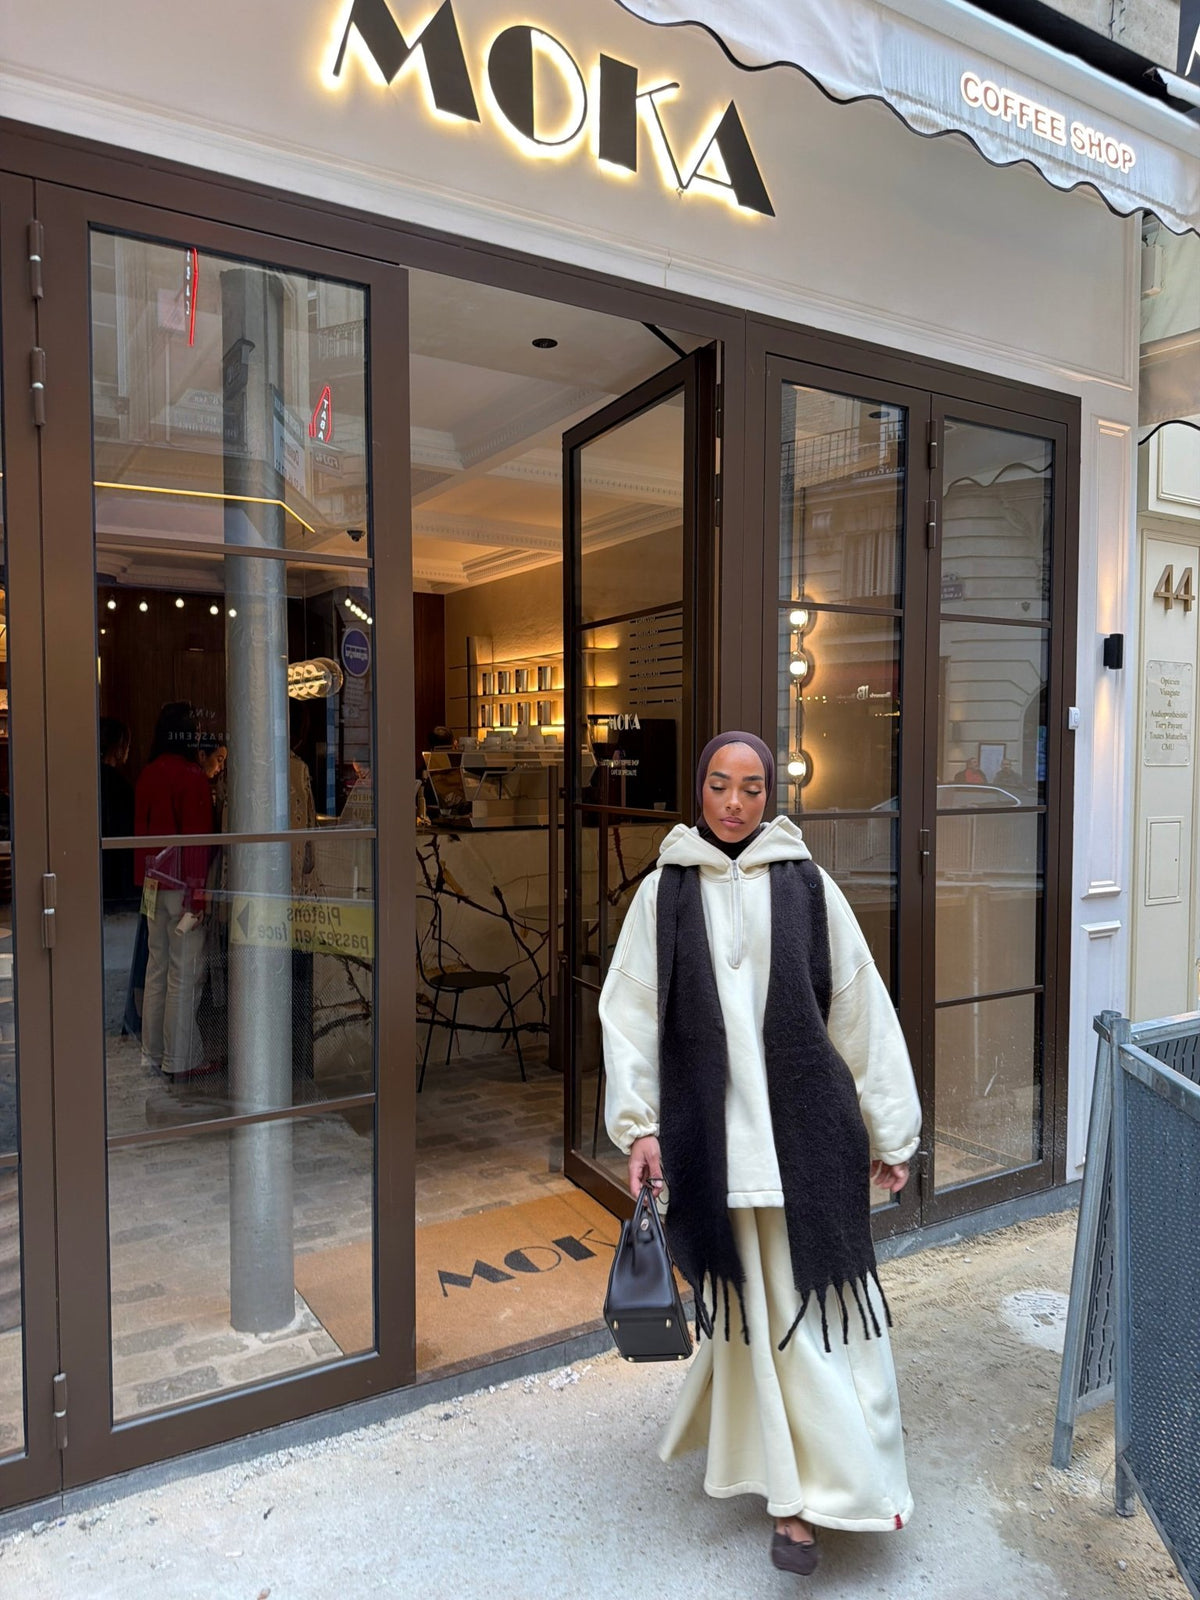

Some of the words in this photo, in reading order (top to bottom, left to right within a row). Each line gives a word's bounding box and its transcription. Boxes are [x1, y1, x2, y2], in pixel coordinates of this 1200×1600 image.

[332, 0, 776, 217] MOKA
[962, 73, 1066, 145] COFFEE
[1071, 122, 1135, 173] SHOP
[1153, 564, 1196, 612] 44
[438, 1229, 616, 1298] MOK
